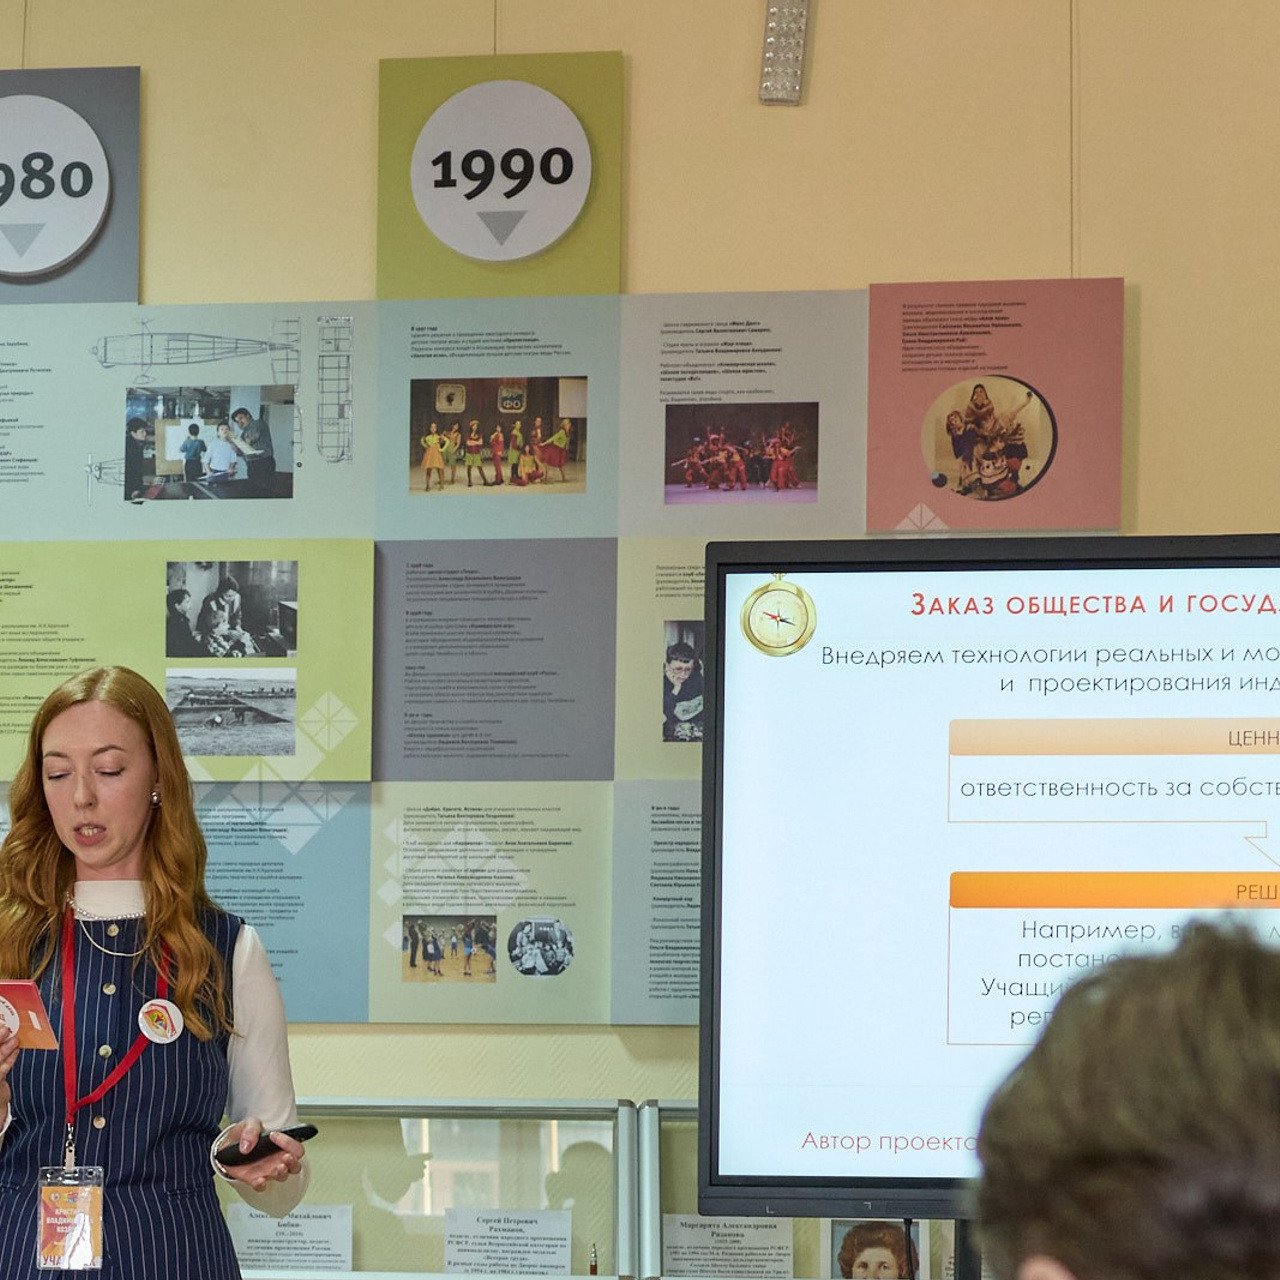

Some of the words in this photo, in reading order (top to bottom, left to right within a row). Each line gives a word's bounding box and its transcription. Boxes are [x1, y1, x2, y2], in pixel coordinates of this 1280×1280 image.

[431, 146, 575, 201] 1990
[1005, 595, 1147, 616] ОБЩЕСТВА
[1159, 595, 1174, 613] И
[1187, 594, 1280, 615] ГОСУД
[822, 646, 944, 669] Внедряем
[951, 648, 1087, 665] технологии
[1095, 647, 1214, 667] реальных
[1221, 648, 1235, 662] и
[1000, 678, 1014, 692] и
[1029, 676, 1231, 696] проектирования
[1228, 730, 1280, 747] ЦЕНН
[960, 780, 1158, 797] ответственность
[1165, 781, 1191, 797] за
[1022, 920, 1162, 943] Например,
[801, 1131, 872, 1154] Автор
